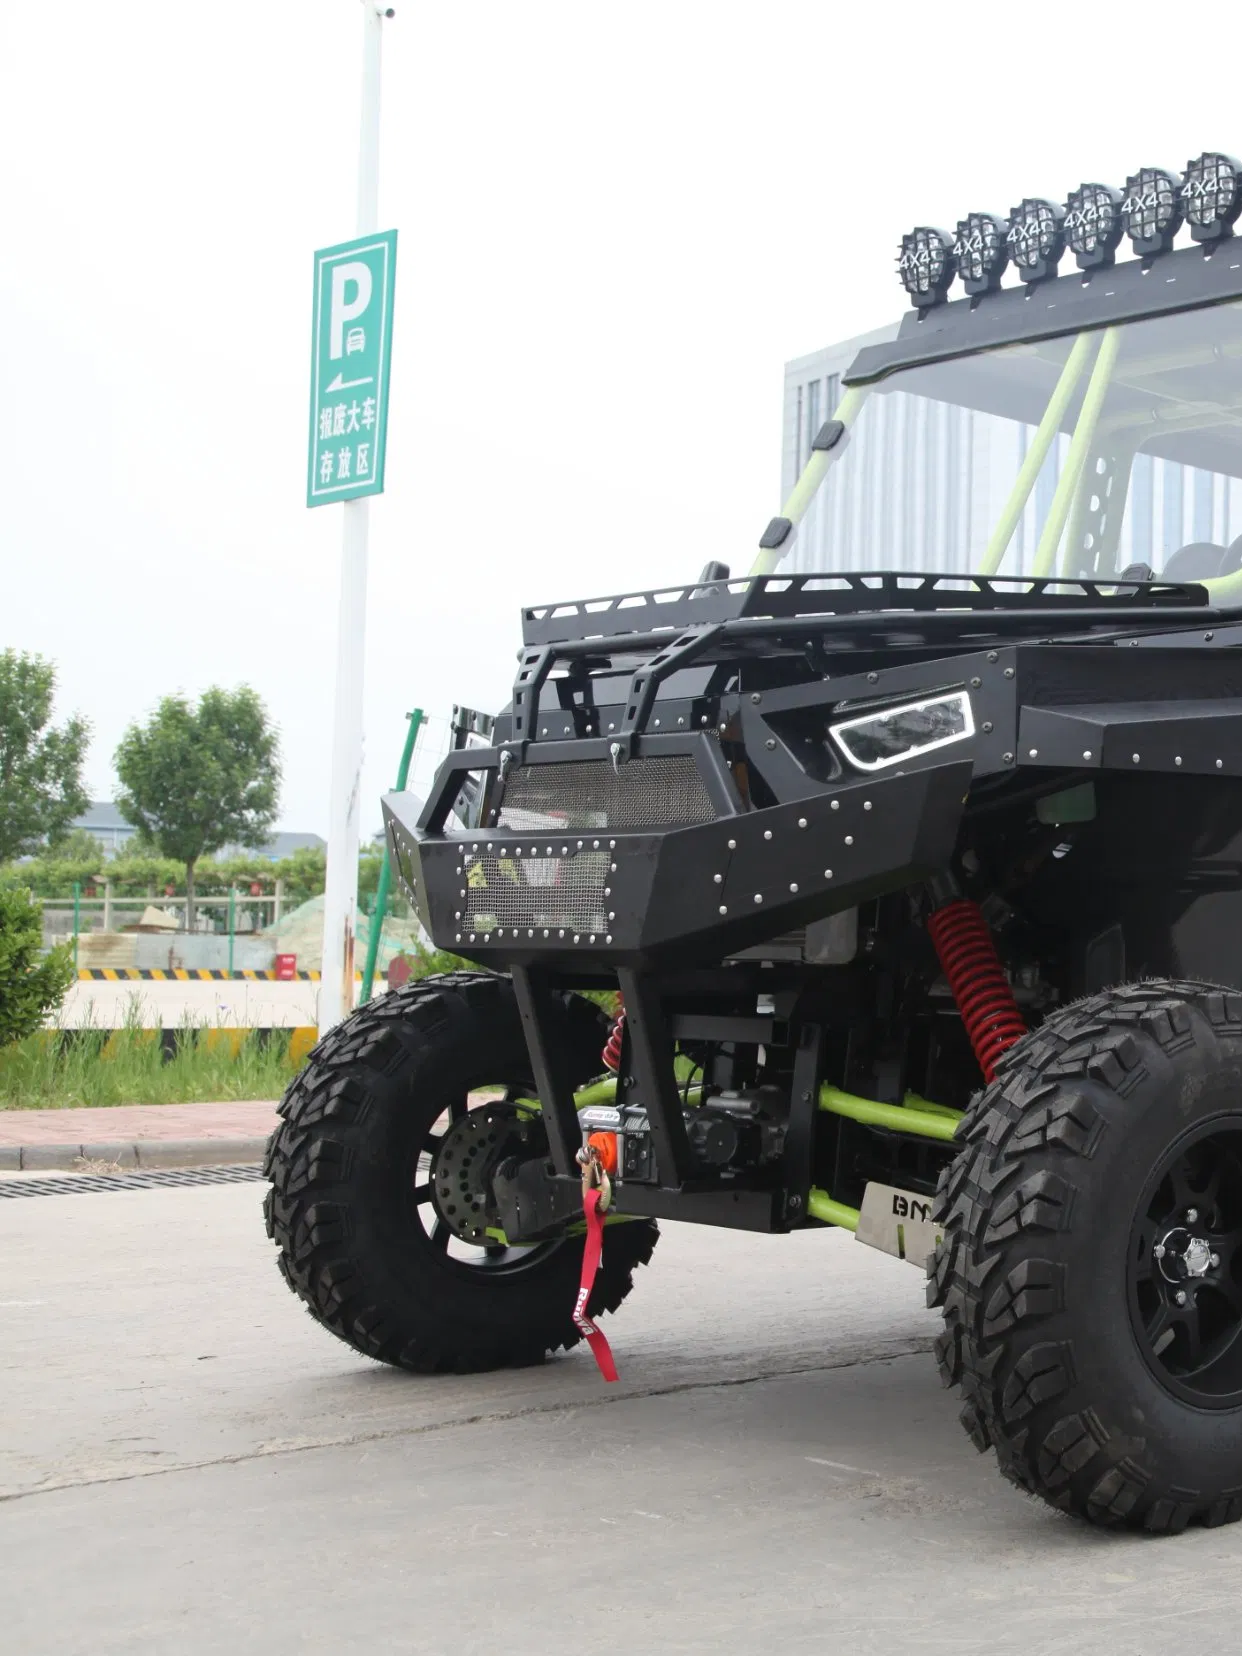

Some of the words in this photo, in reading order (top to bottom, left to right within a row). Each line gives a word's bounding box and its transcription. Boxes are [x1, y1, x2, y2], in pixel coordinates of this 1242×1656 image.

[330, 261, 373, 360] P
[320, 396, 376, 440] 报废大车
[320, 443, 370, 484] 存放区
